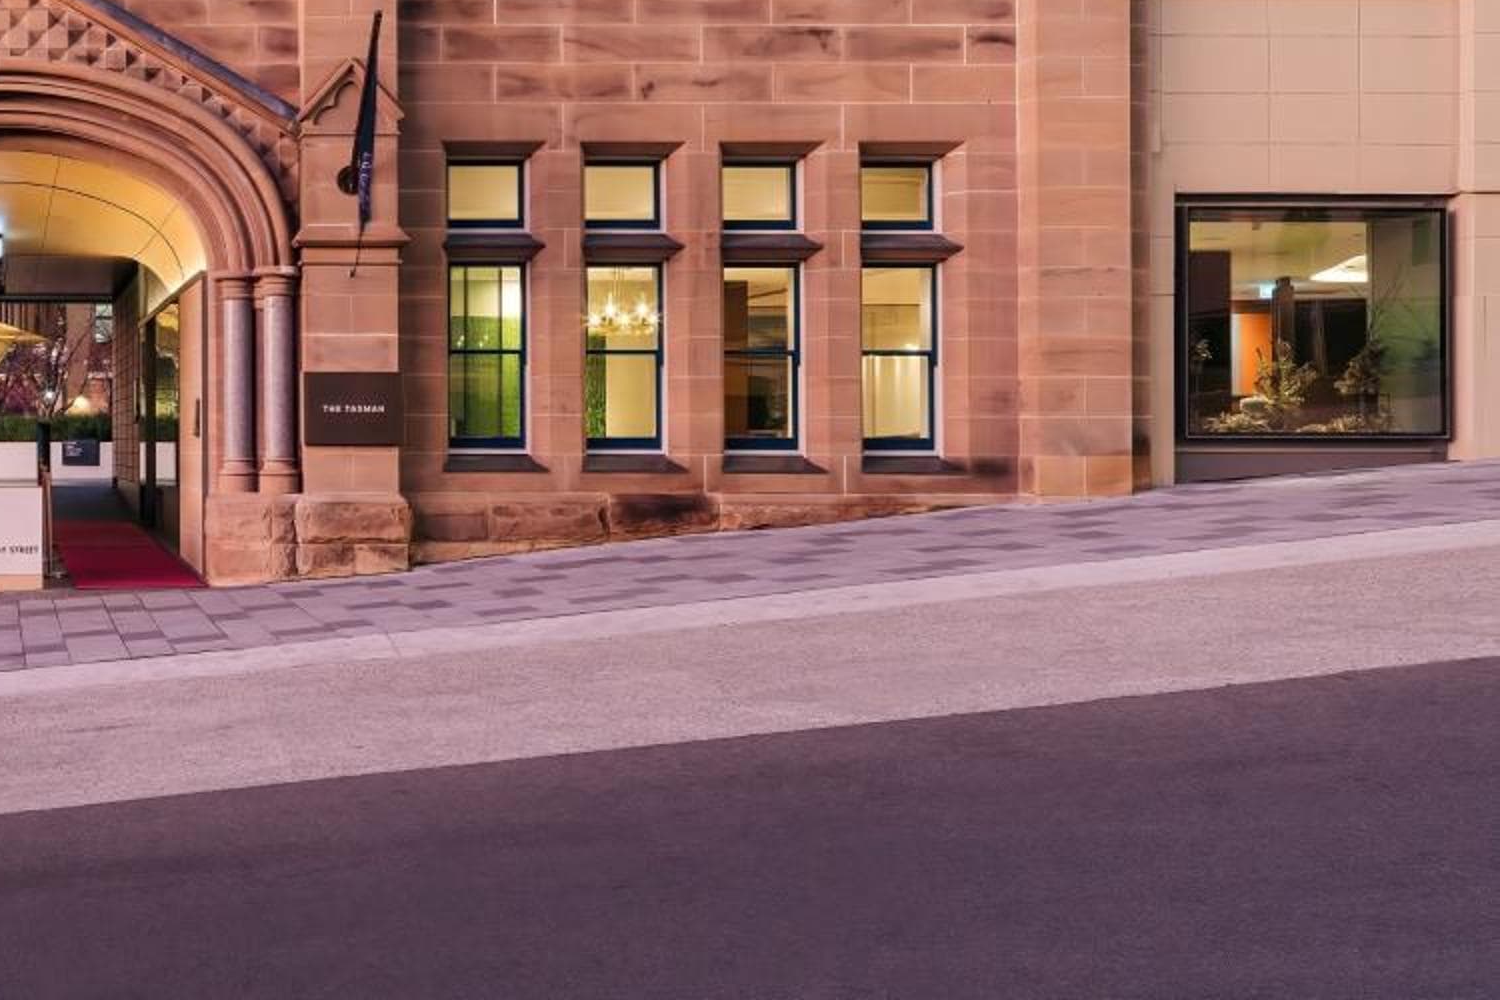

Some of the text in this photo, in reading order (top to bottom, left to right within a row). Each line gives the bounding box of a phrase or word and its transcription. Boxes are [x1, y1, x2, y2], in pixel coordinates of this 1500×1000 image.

[323, 404, 385, 413] THE TASMAN
[9, 545, 39, 554] STREET
